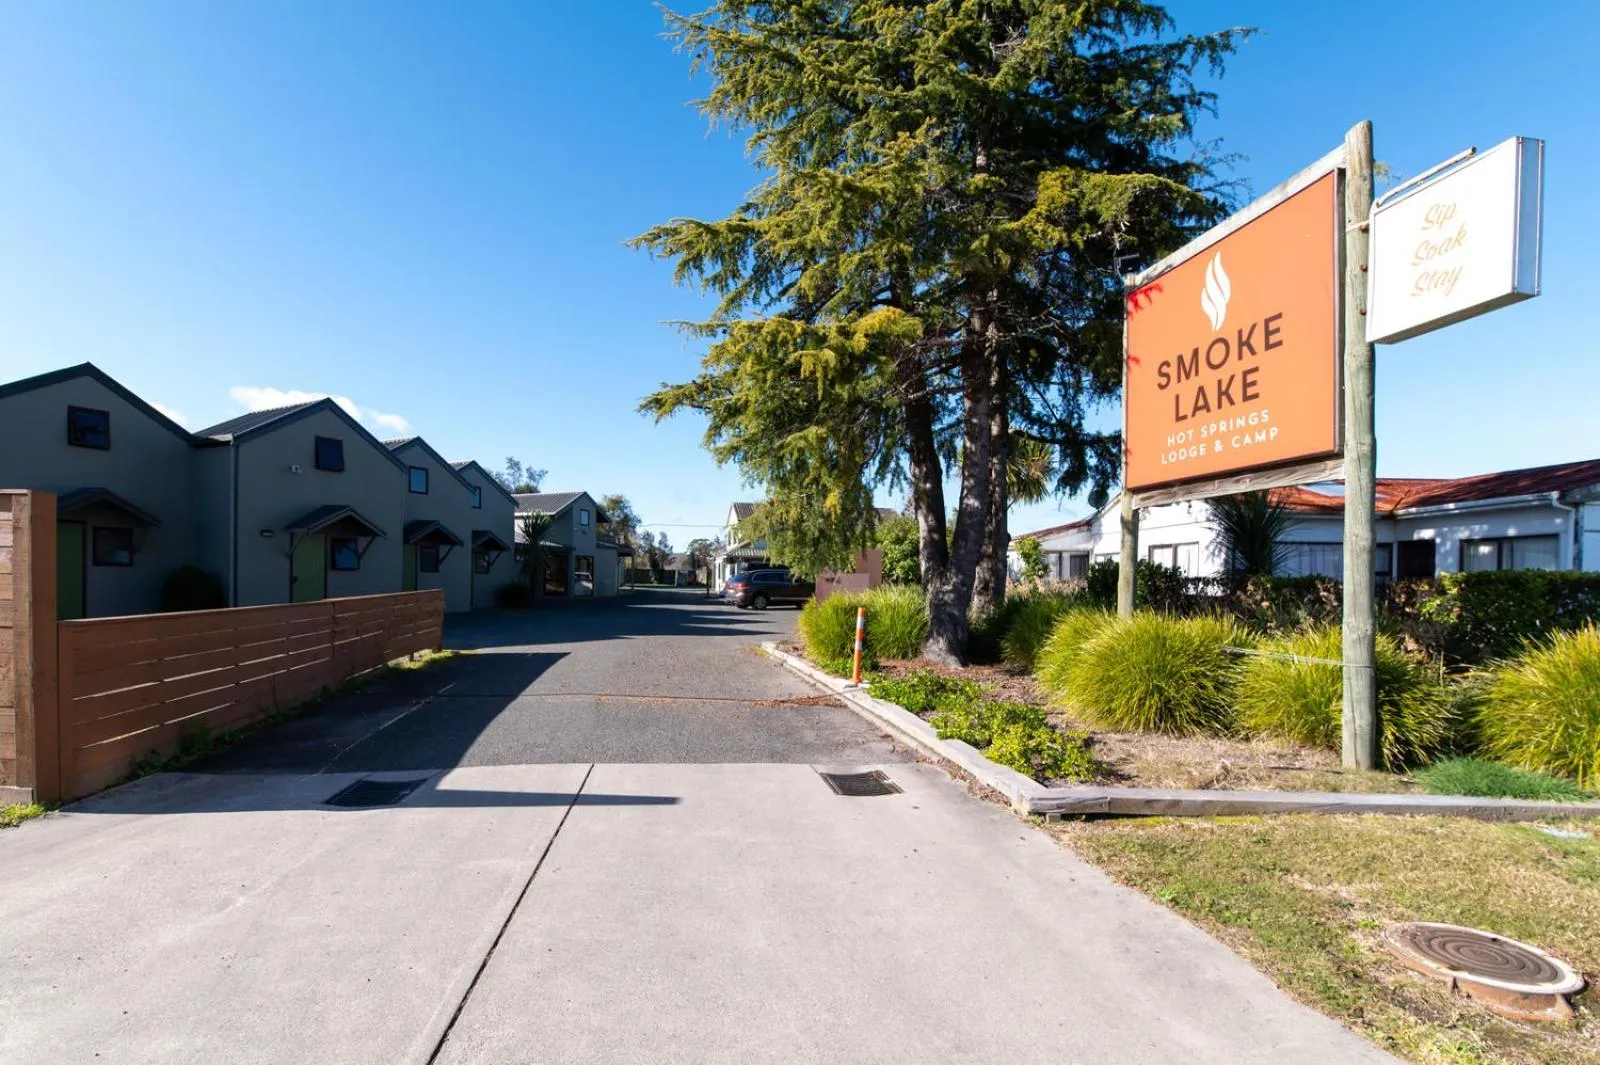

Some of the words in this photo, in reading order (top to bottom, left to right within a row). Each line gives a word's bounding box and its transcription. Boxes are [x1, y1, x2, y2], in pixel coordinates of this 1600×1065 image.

[1421, 202, 1457, 230] Sip
[1411, 223, 1467, 266] Soak
[1411, 265, 1464, 297] Stay
[1157, 312, 1284, 390] SMOKE
[1174, 366, 1260, 423] LAKE
[1161, 444, 1207, 465] LODGE
[1214, 439, 1224, 452] &
[1231, 427, 1280, 448] CAMP
[1167, 430, 1194, 446] HOT
[1200, 410, 1270, 438] SPRINGS
